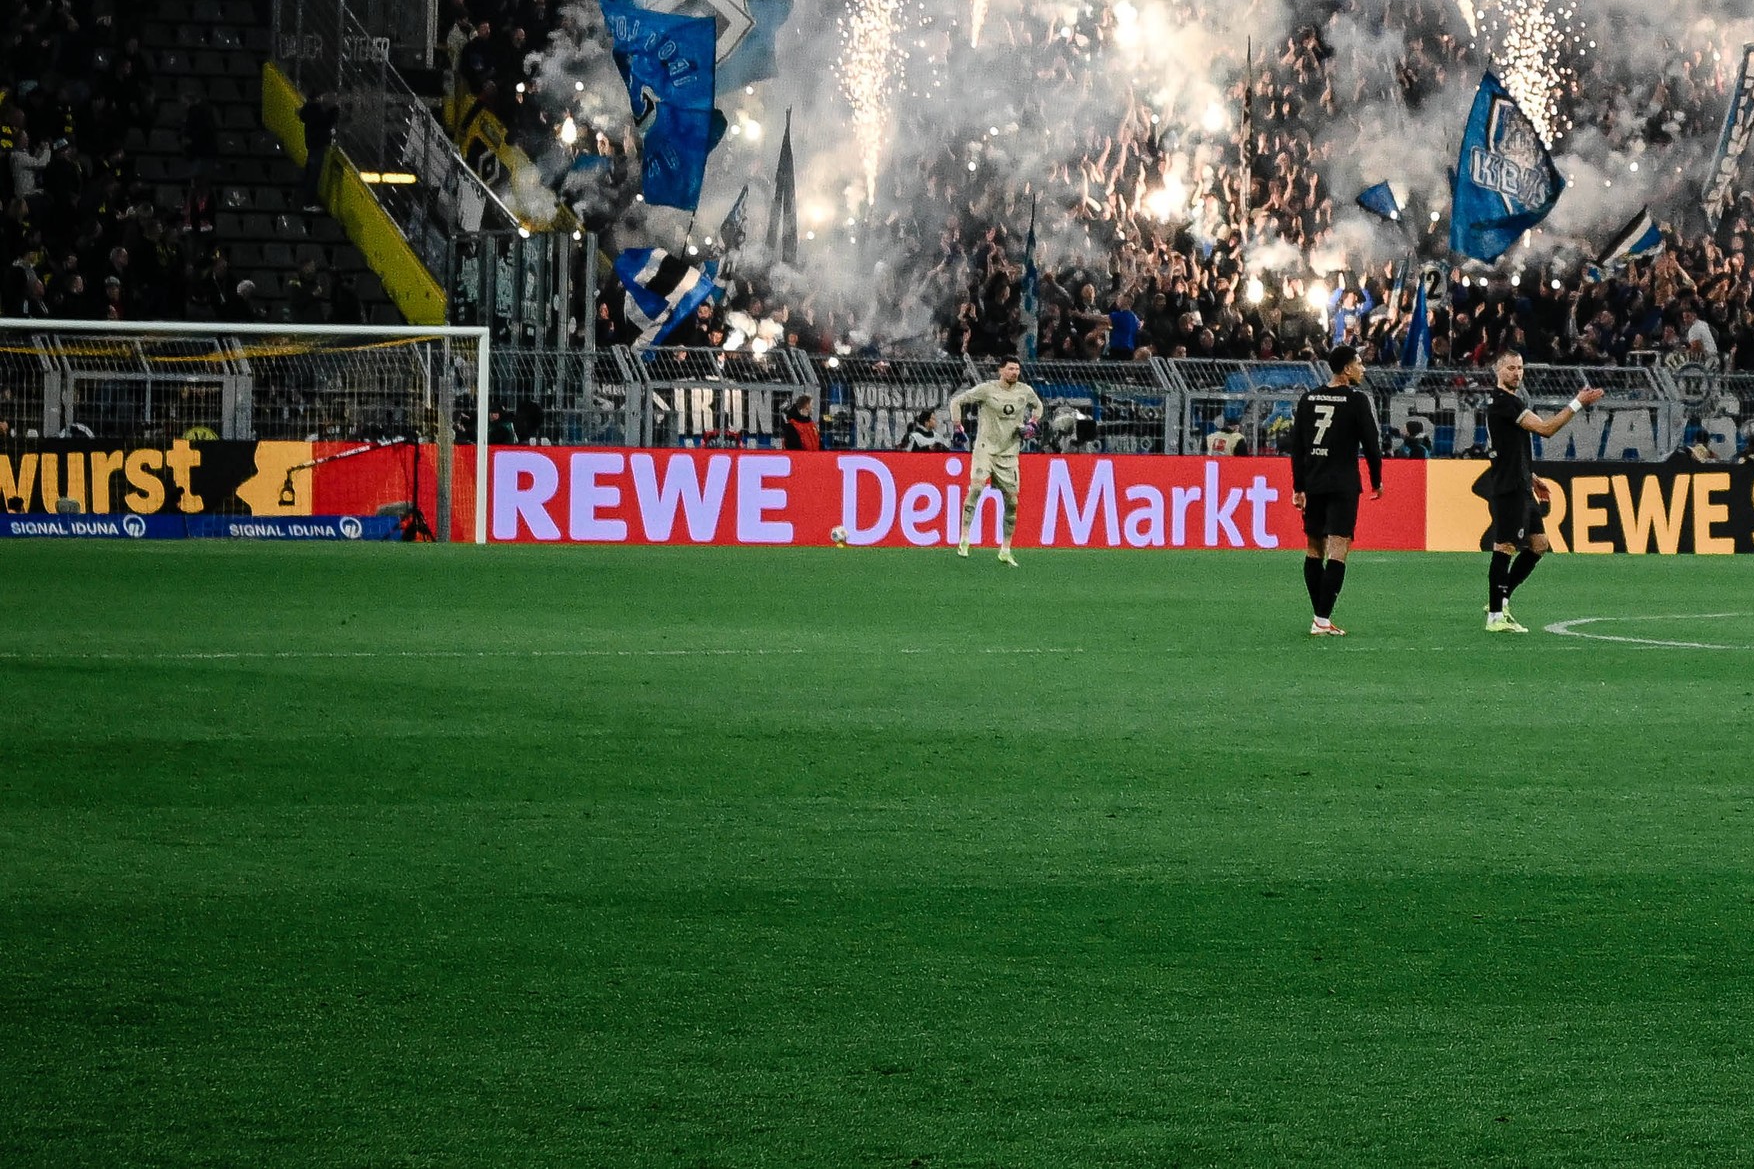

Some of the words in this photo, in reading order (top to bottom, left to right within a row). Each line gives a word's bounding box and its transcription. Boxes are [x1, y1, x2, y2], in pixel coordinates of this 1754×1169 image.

[1312, 404, 1335, 445] 7
[492, 450, 794, 542] REWE
[1042, 457, 1280, 549] Markt
[10, 521, 68, 535] SIGNAL
[71, 522, 119, 535] IDUNA
[229, 523, 286, 537] SIGNAL
[288, 524, 336, 538] IDUNA
